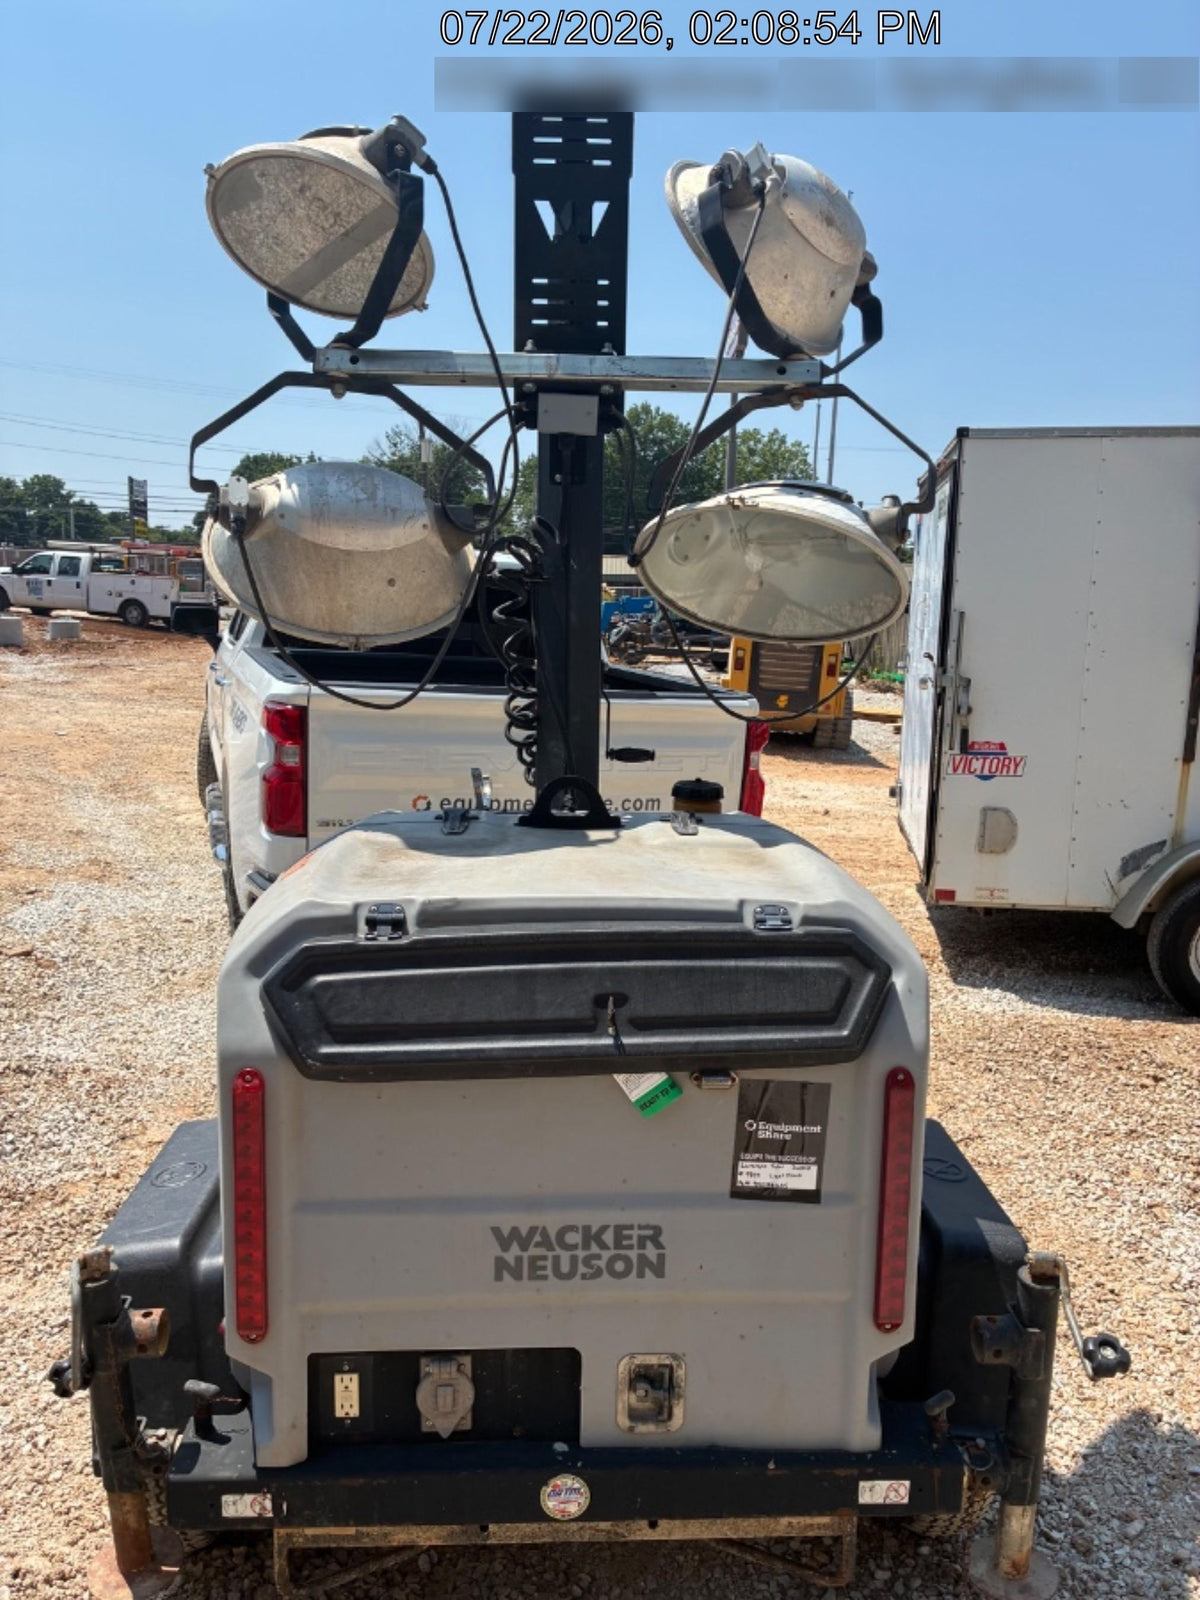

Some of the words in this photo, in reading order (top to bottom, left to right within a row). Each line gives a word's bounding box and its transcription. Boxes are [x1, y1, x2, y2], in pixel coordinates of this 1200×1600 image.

[951, 756, 1024, 774] VICTORY
[757, 1130, 792, 1140] Share
[758, 1120, 823, 1134] Equipment
[490, 1225, 666, 1252] WACKER
[494, 1253, 666, 1281] NEUSON
